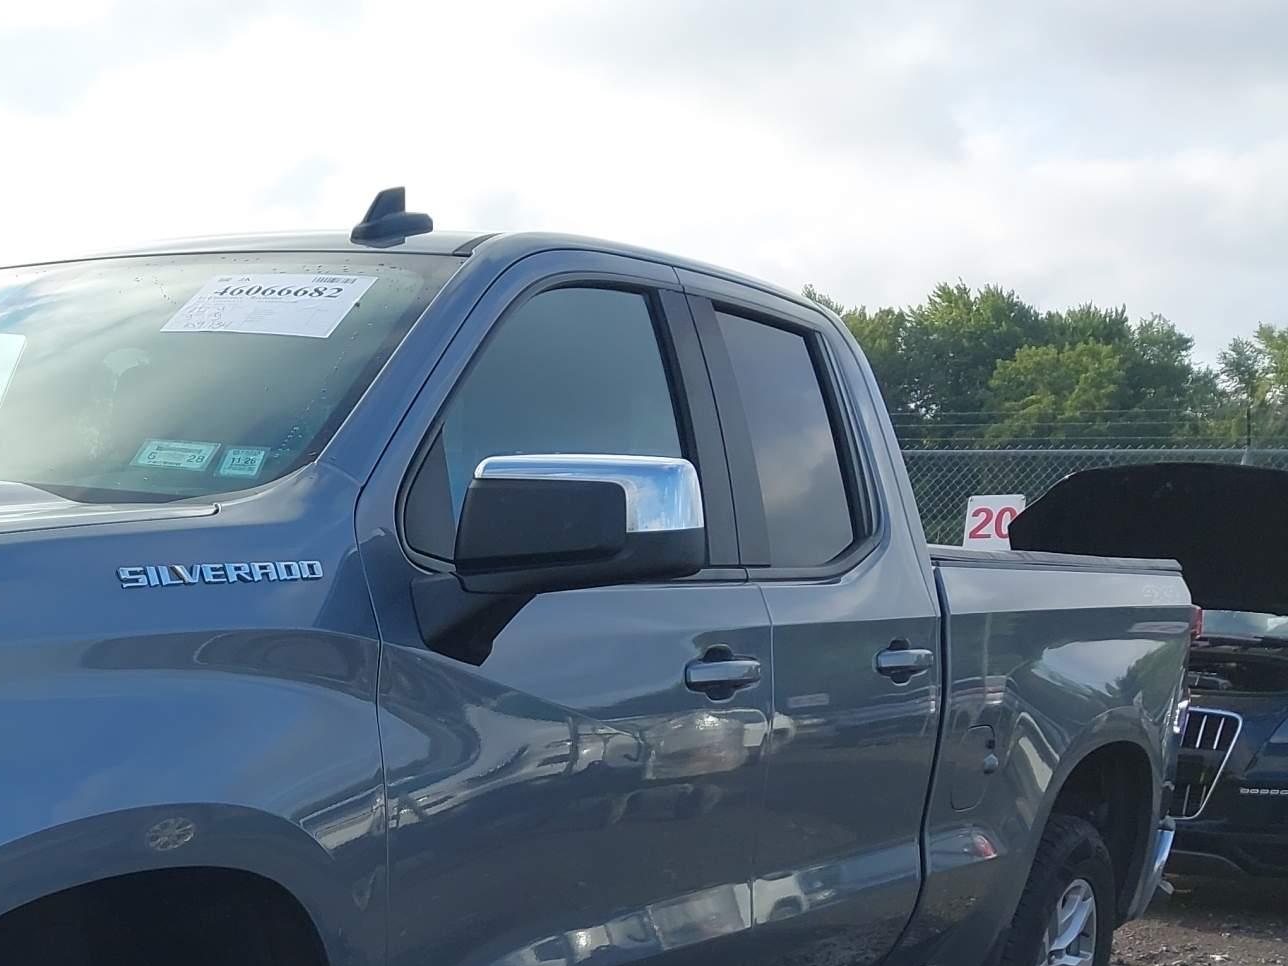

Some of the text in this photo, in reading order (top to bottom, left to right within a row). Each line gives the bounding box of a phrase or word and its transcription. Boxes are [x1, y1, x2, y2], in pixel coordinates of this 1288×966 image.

[214, 285, 344, 299] 46066682
[186, 454, 206, 463] 28
[968, 507, 1018, 540] 20
[118, 560, 324, 589] SILVERADO
